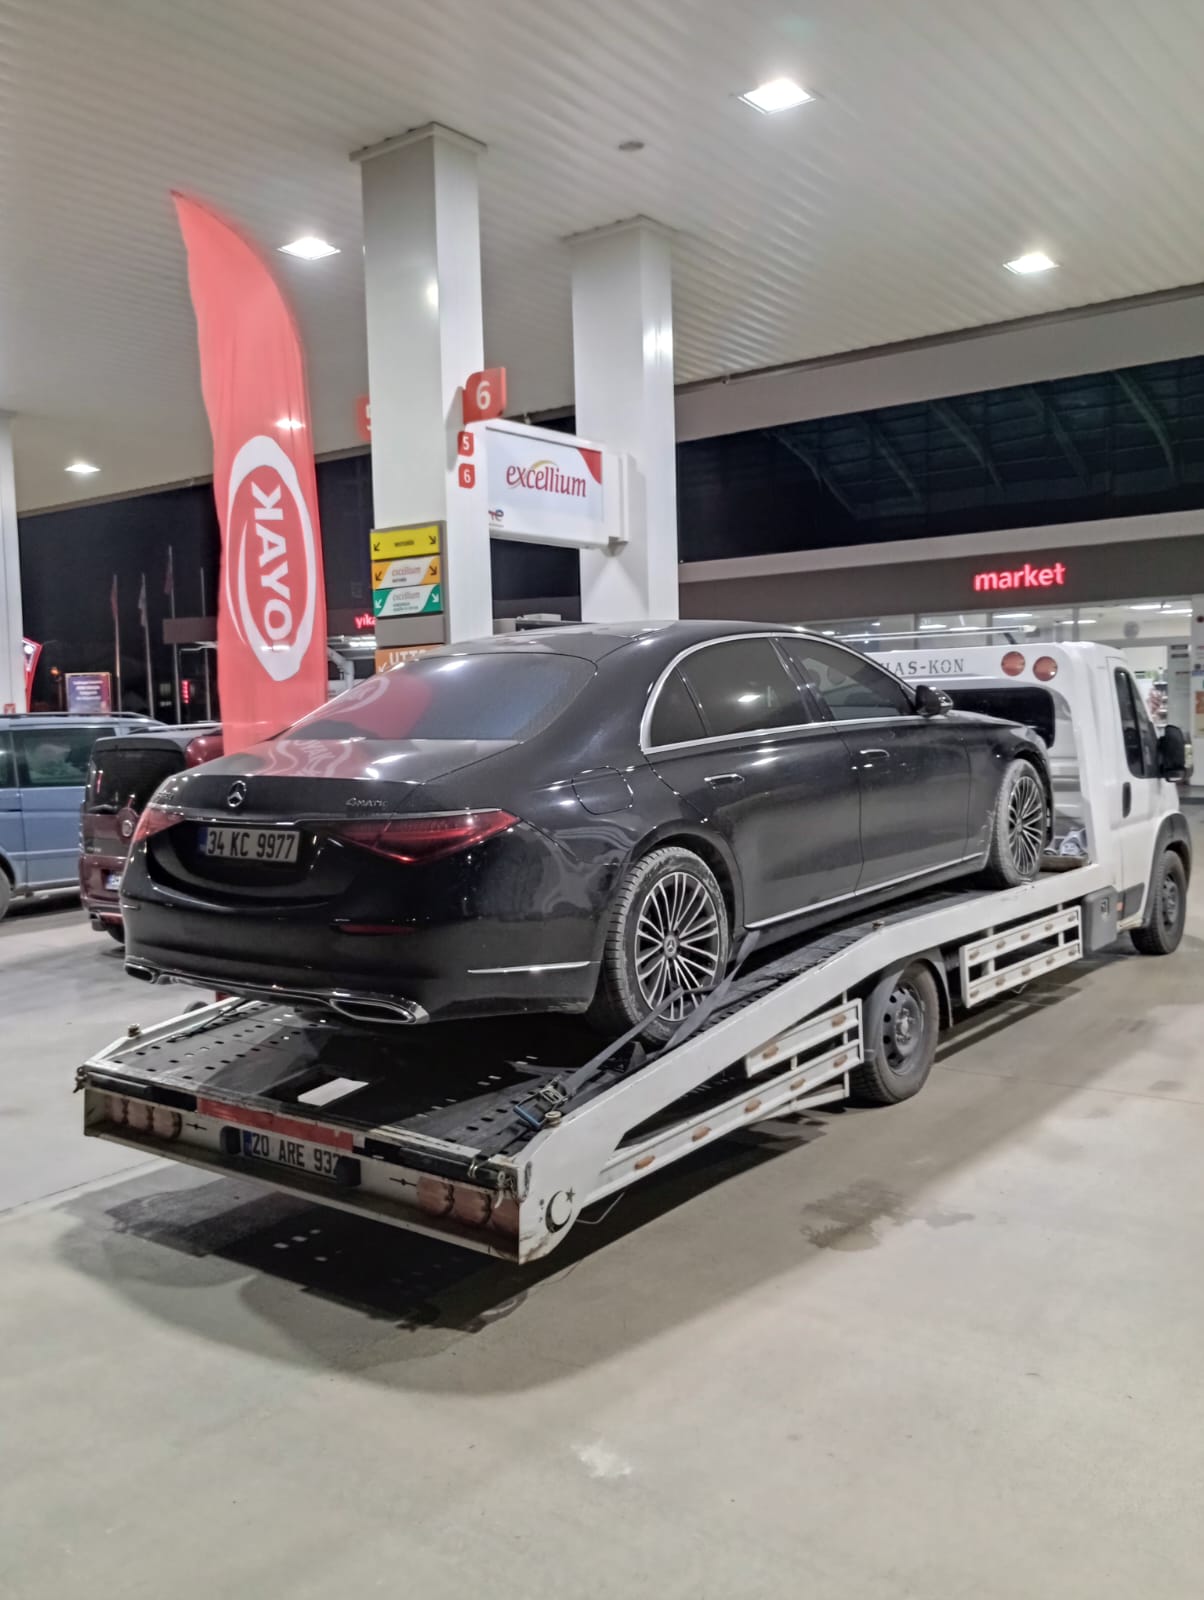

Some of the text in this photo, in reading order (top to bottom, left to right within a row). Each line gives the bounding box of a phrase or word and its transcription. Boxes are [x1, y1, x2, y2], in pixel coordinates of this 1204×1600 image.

[476, 380, 491, 410] 6
[462, 436, 470, 450] 5
[463, 469, 471, 483] 6
[506, 465, 586, 497] excellium
[974, 562, 1066, 591] market
[389, 649, 426, 666] UTT
[207, 830, 295, 860] 34 KC 9977
[253, 1133, 269, 1157] 20
[279, 1140, 305, 1168] ARE
